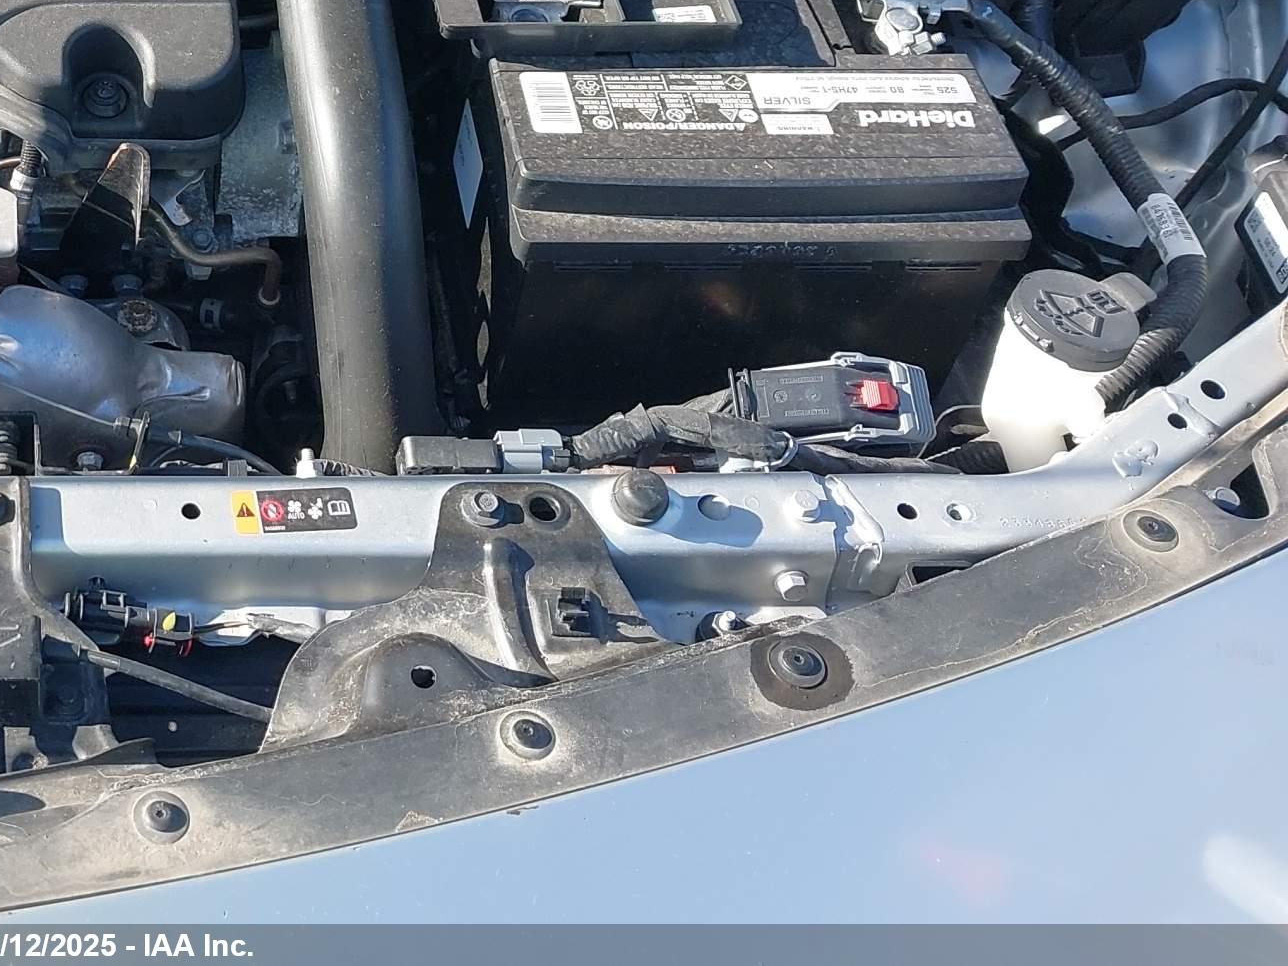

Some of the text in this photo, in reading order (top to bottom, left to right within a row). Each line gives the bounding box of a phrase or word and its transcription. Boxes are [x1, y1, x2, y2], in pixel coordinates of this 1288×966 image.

[888, 85, 905, 94] 80
[936, 85, 958, 94] 525
[763, 96, 812, 106] SILVER
[859, 110, 975, 127] DieHard
[623, 121, 735, 131] DANGER/POISON
[287, 512, 304, 520] AUTO
